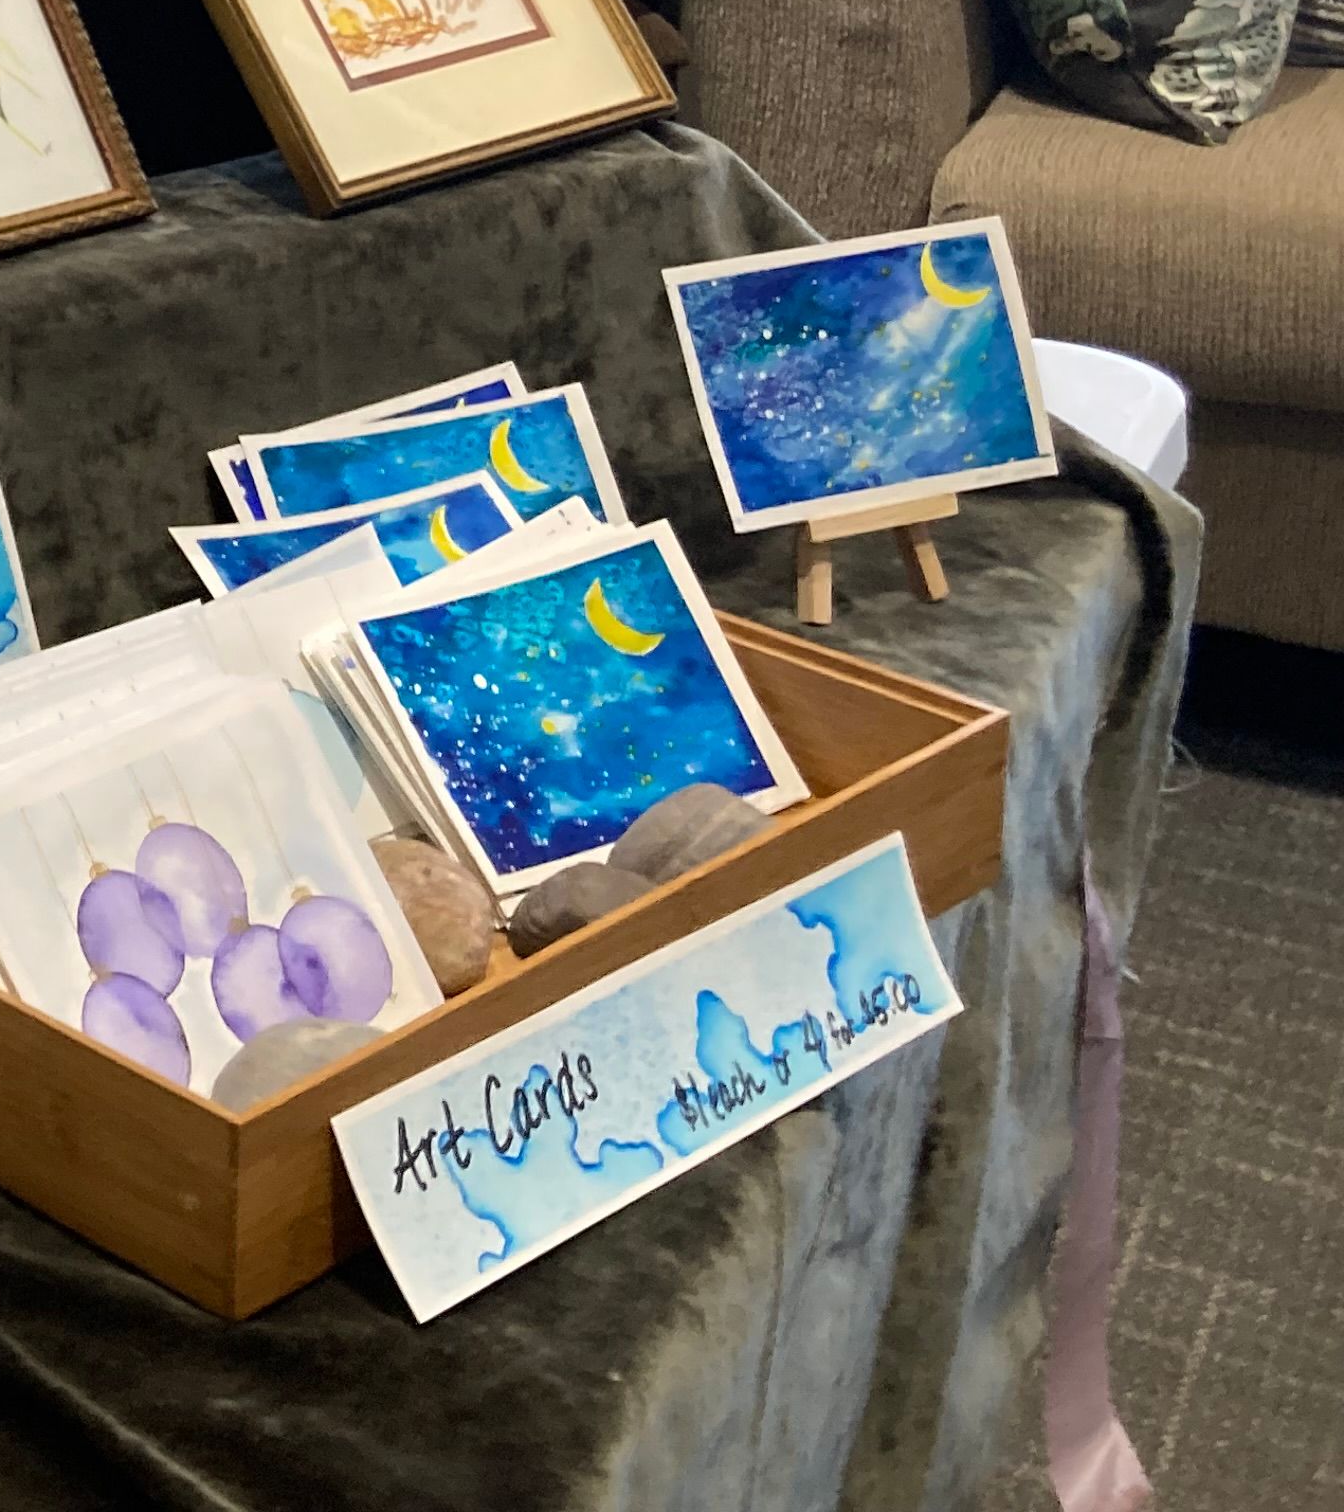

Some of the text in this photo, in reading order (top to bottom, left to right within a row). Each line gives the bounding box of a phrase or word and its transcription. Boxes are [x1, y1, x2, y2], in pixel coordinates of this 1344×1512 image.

[803, 1009, 828, 1064] 4
[393, 1051, 599, 1194] Art Cards
